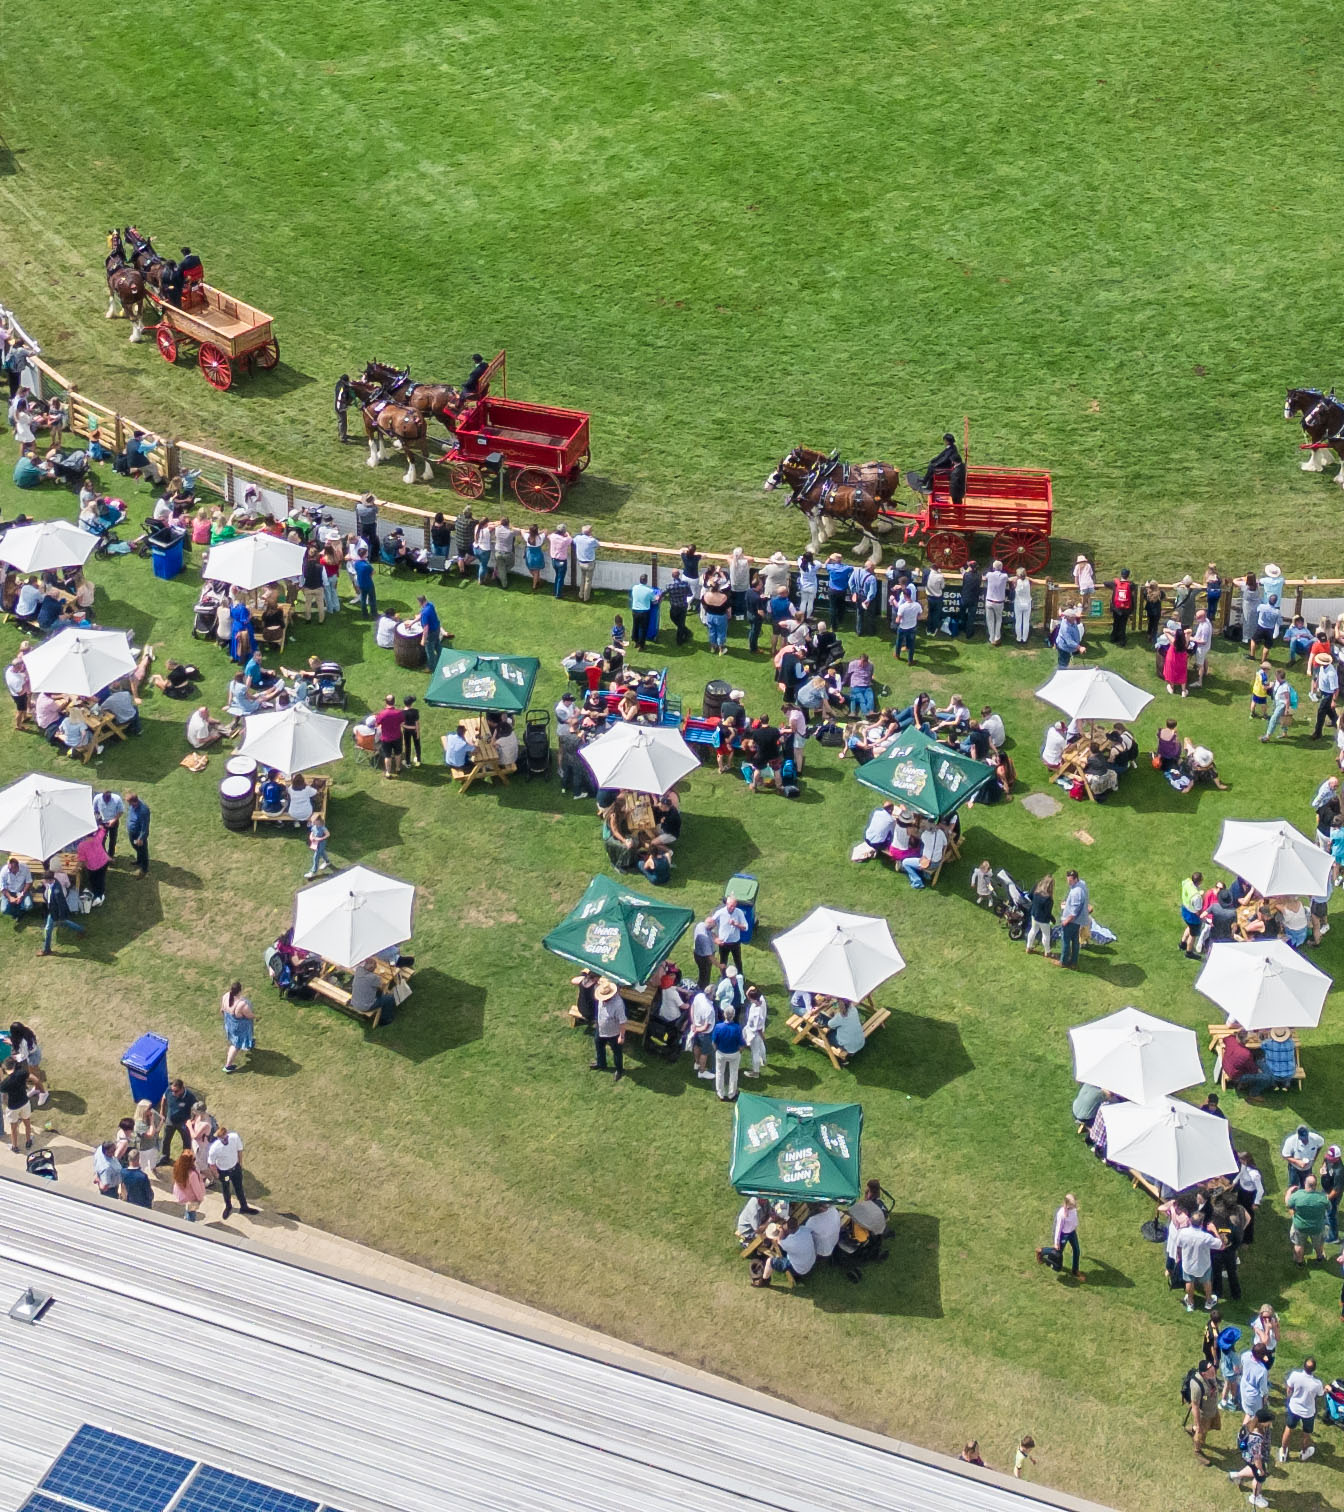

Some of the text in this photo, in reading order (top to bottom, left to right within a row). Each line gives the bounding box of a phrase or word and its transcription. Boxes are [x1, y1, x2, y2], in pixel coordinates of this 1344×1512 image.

[594, 927, 620, 935] INNIS
[586, 944, 611, 955] GUNN
[785, 1147, 812, 1161] INNIS
[794, 1161, 803, 1170] &
[783, 1170, 812, 1183] GUNN
